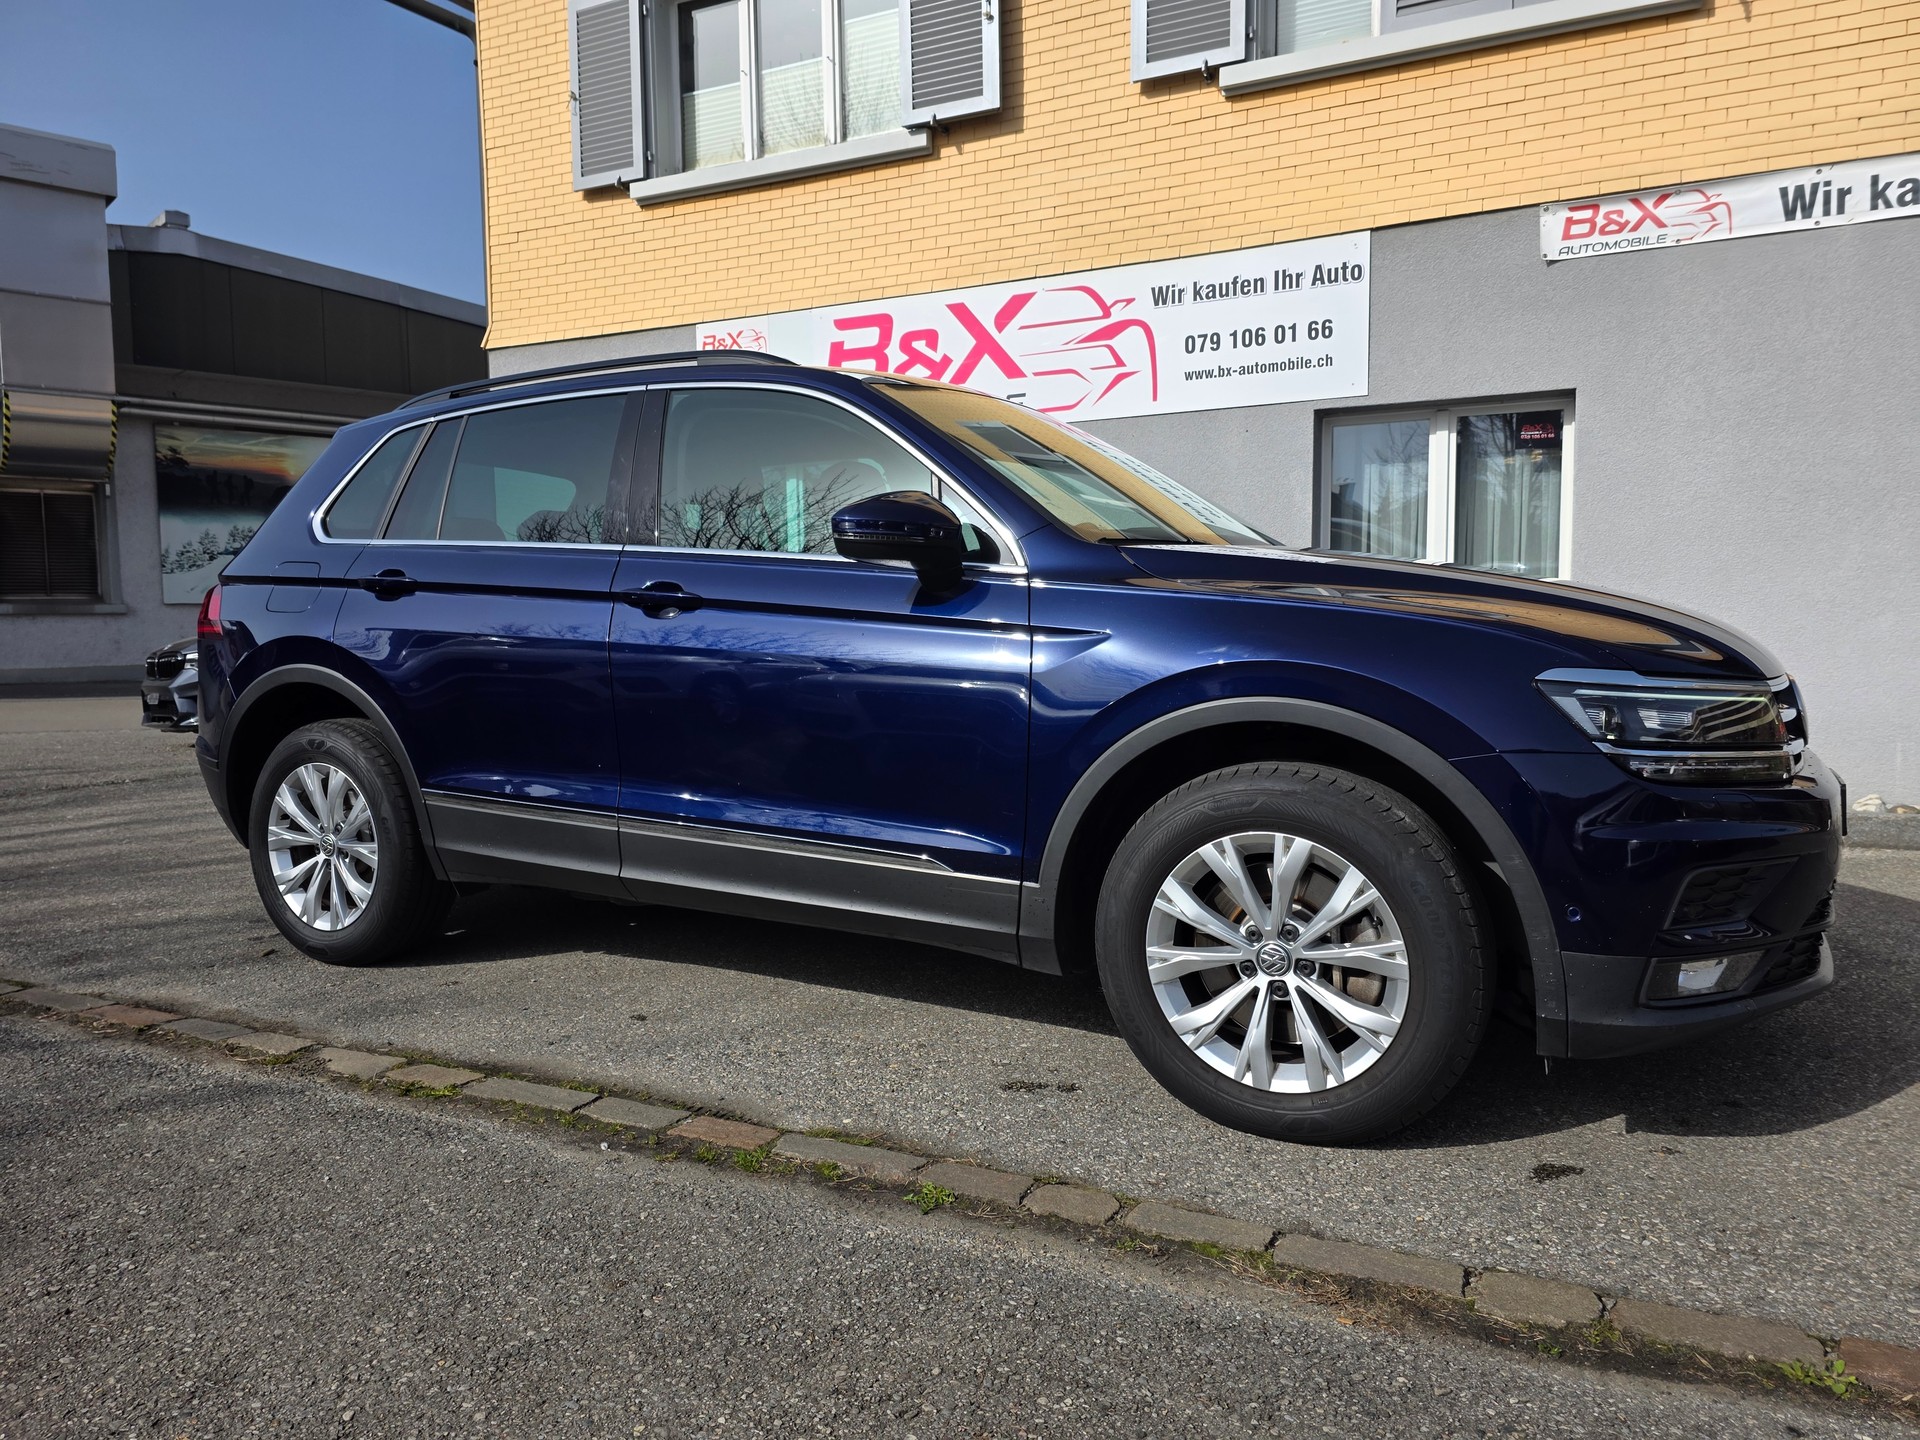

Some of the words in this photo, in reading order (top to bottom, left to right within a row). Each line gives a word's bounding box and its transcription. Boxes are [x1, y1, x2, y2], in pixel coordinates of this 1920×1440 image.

[1561, 192, 1677, 241] B&X
[1779, 180, 1852, 222] Wir
[1870, 174, 1920, 211] ka
[1558, 234, 1667, 256] AUTOMOBILE
[1151, 285, 1185, 307] Wir
[1193, 275, 1265, 302] kaufen
[1274, 268, 1303, 291] Ihr
[1311, 261, 1363, 287] Auto
[1184, 332, 1221, 354] 079
[1229, 327, 1266, 349] 106
[1274, 323, 1297, 344] 01
[1307, 319, 1333, 341] 66
[1184, 354, 1333, 381] www.bx-automobile.ch
